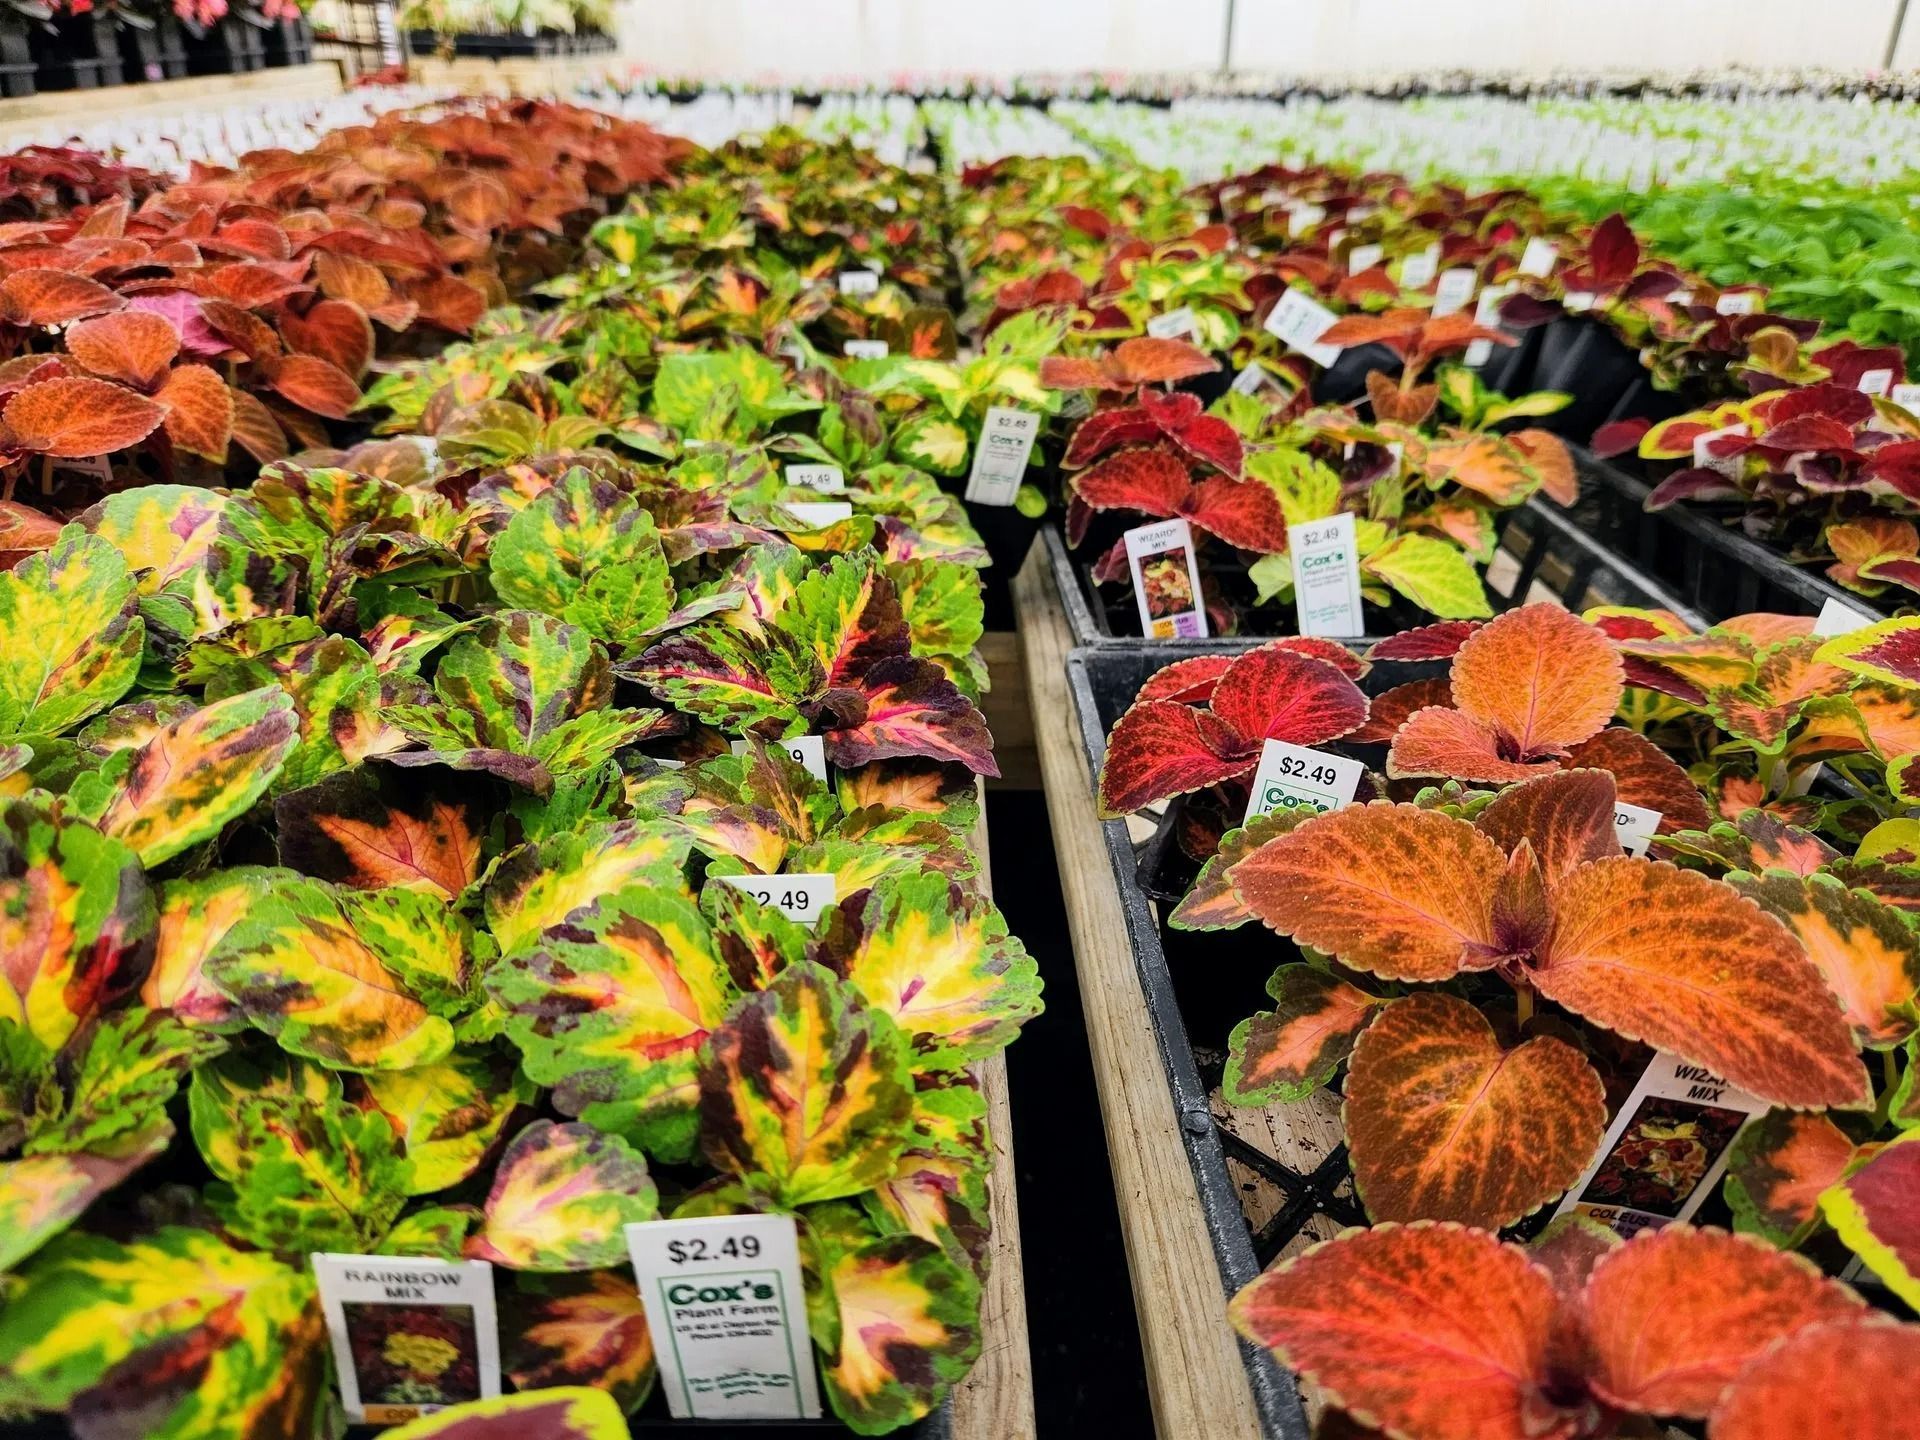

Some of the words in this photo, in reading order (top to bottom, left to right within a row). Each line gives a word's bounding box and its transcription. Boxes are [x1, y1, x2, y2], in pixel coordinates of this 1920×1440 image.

[1303, 527, 1339, 546] $2.49
[1302, 552, 1343, 569] Cox's
[1280, 756, 1337, 786] $2.49
[1687, 1085, 1725, 1102] MIX
[1589, 1208, 1650, 1227] COLEUS
[668, 1235, 760, 1265] $2.49
[344, 1269, 461, 1286] RAINBOW
[384, 1287, 426, 1298] MIX
[669, 1280, 774, 1305] Cox's
[675, 1307, 723, 1319] Plant
[729, 1305, 778, 1315] Farm
